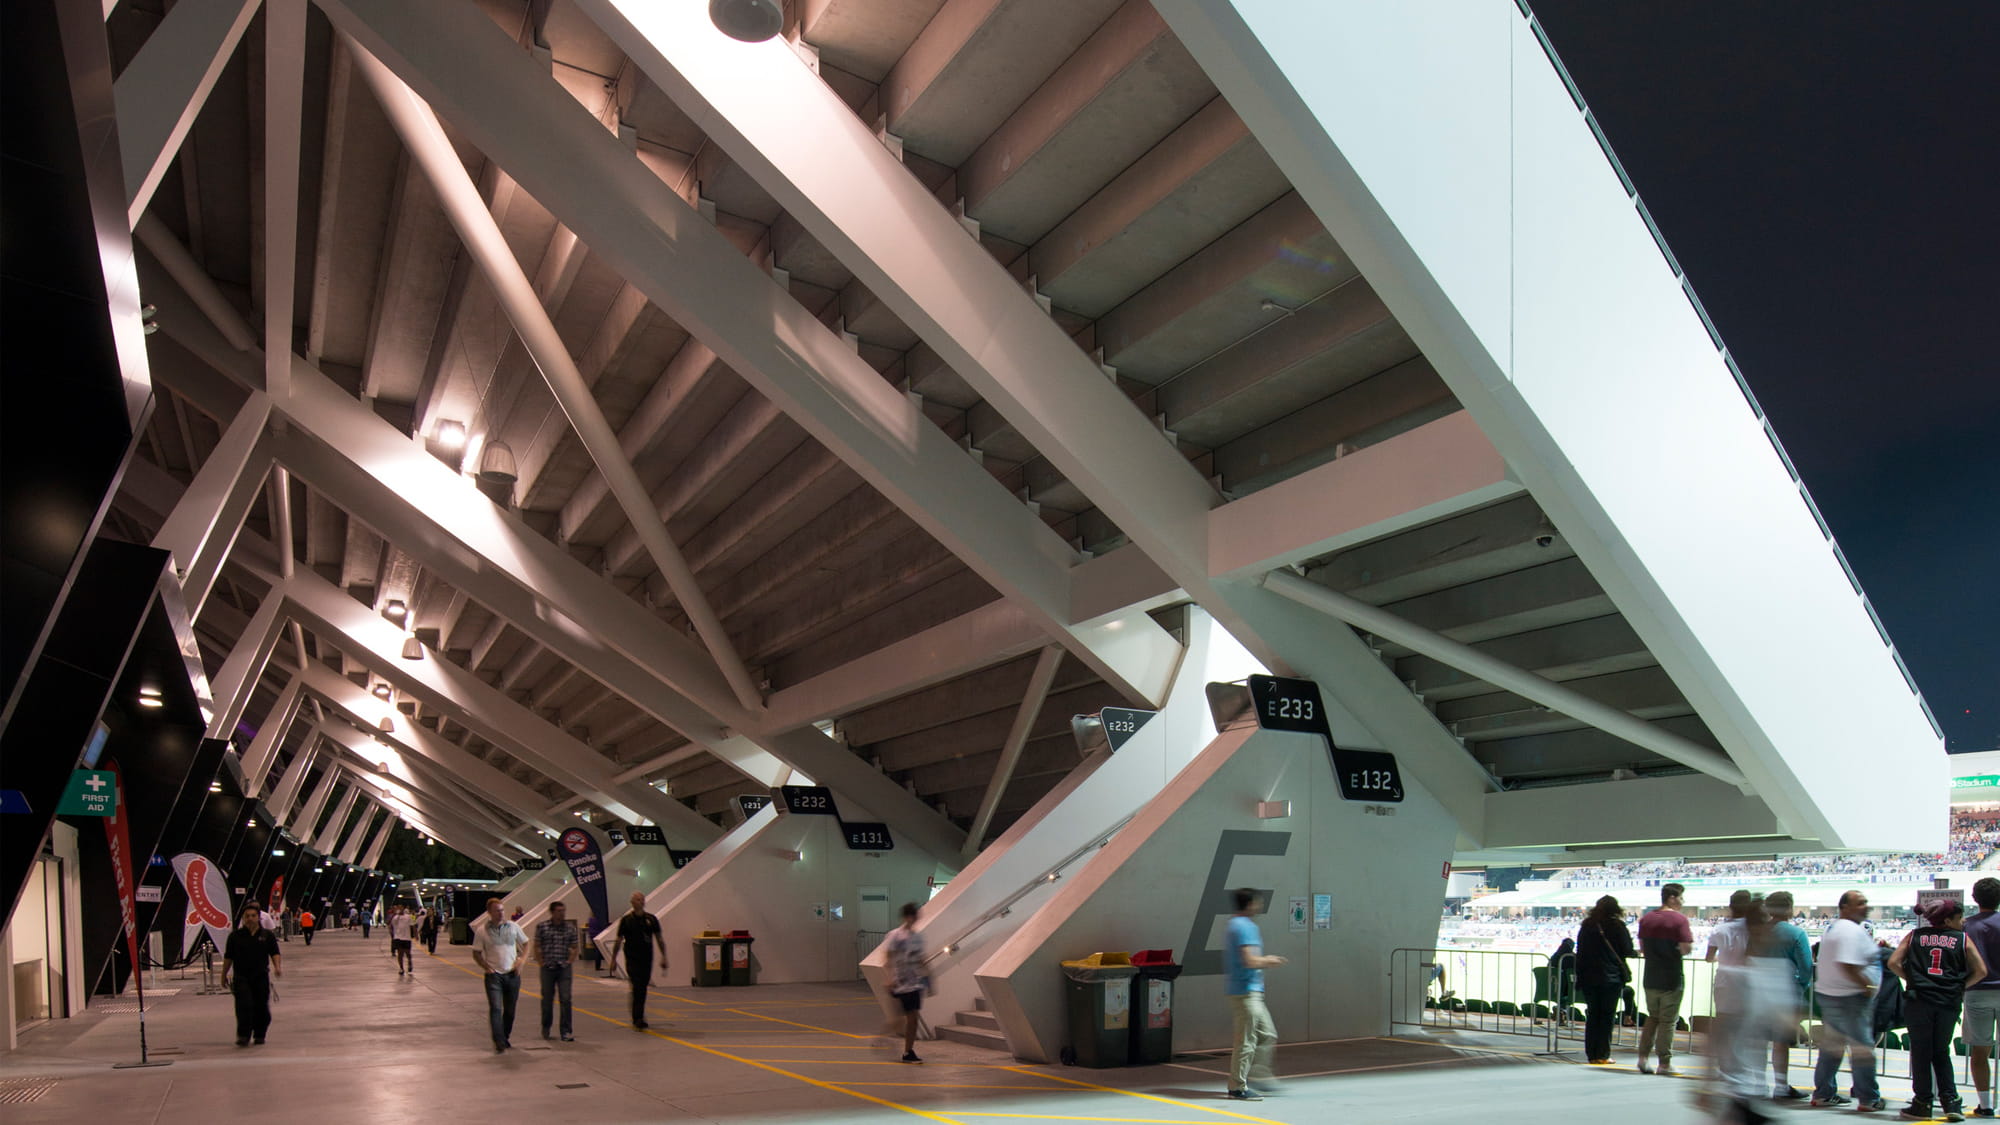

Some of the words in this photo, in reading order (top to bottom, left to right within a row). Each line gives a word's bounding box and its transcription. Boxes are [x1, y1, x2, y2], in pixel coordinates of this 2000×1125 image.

[82, 794, 110, 802] FIRST
[568, 853, 597, 868] Smoke
[576, 864, 596, 875] Free
[577, 871, 602, 885] Event
[1181, 829, 1292, 976] E
[1920, 934, 1958, 949] ROSE
[1927, 948, 1943, 976] 1
